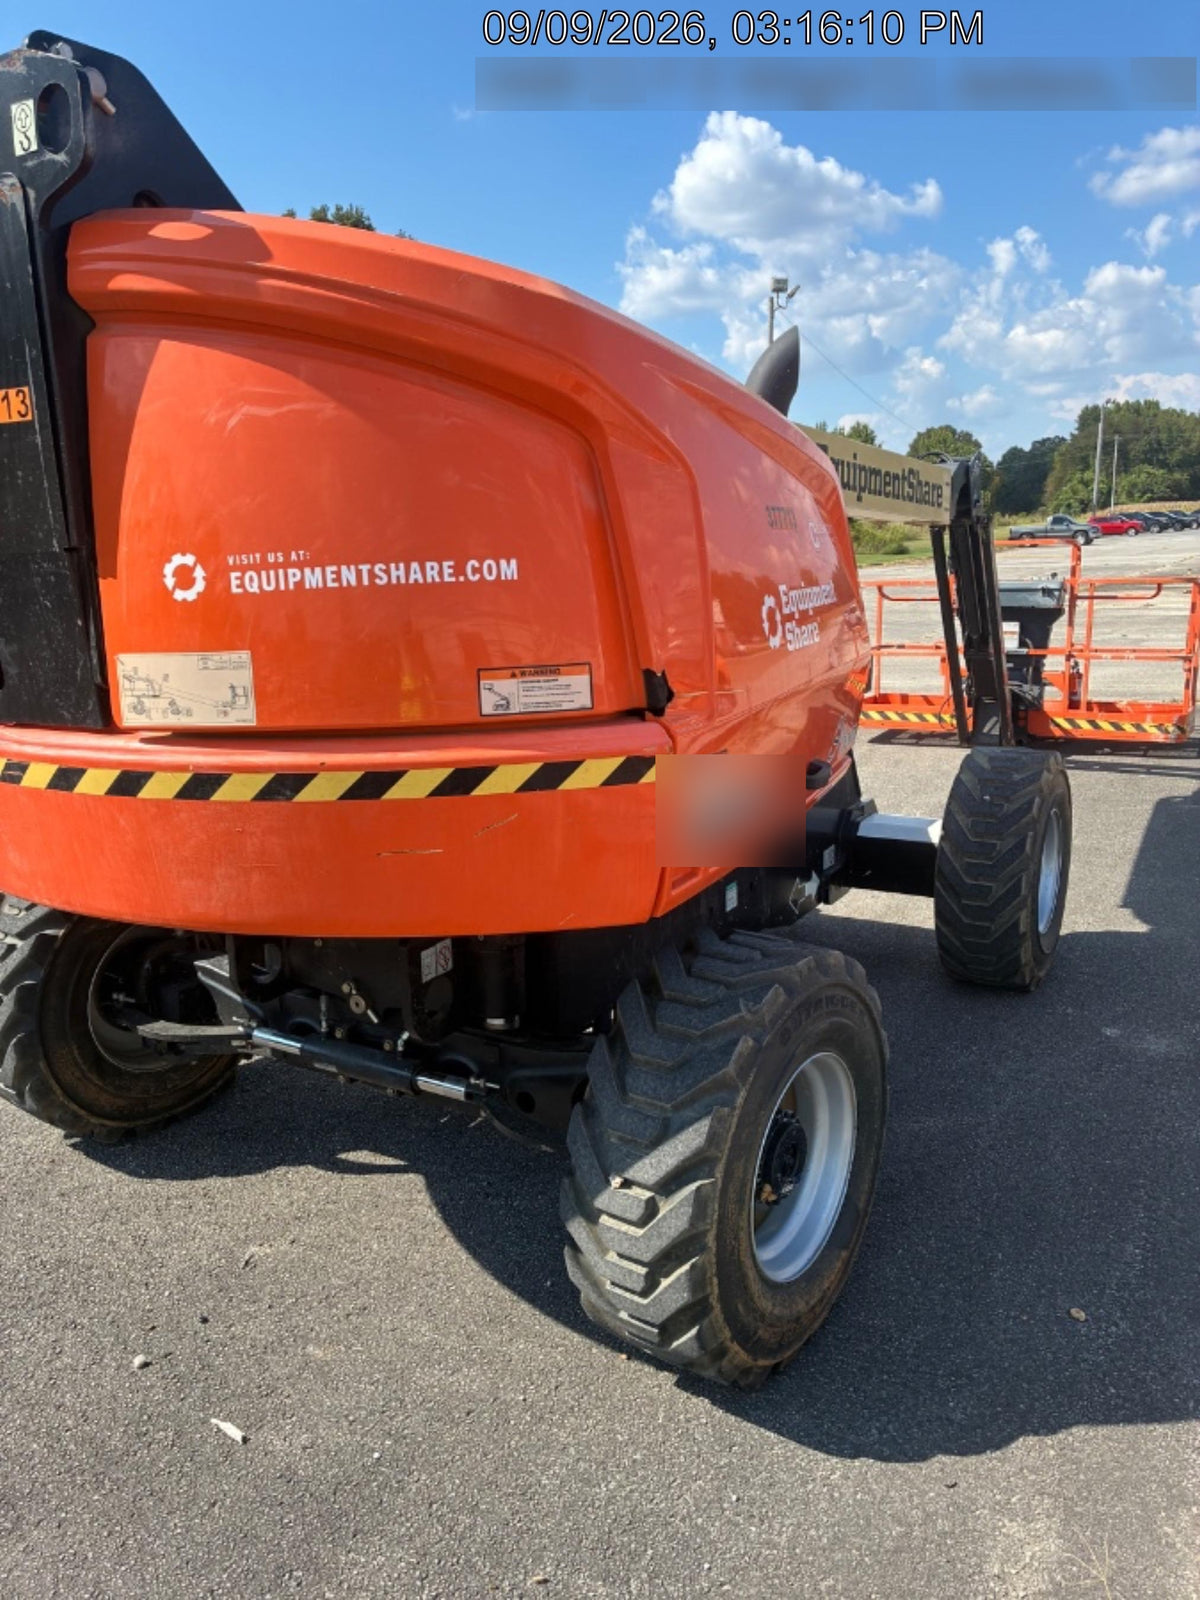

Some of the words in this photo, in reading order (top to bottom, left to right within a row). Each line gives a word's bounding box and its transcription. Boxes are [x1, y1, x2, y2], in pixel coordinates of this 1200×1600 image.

[817, 443, 943, 508] uipmentShare
[227, 553, 261, 566] VISIT
[267, 552, 284, 563] US
[290, 550, 311, 561] AT:
[230, 558, 518, 594] EQUIPMENTSHARE.COM
[785, 621, 820, 651] Share
[520, 668, 560, 678] WARNING
